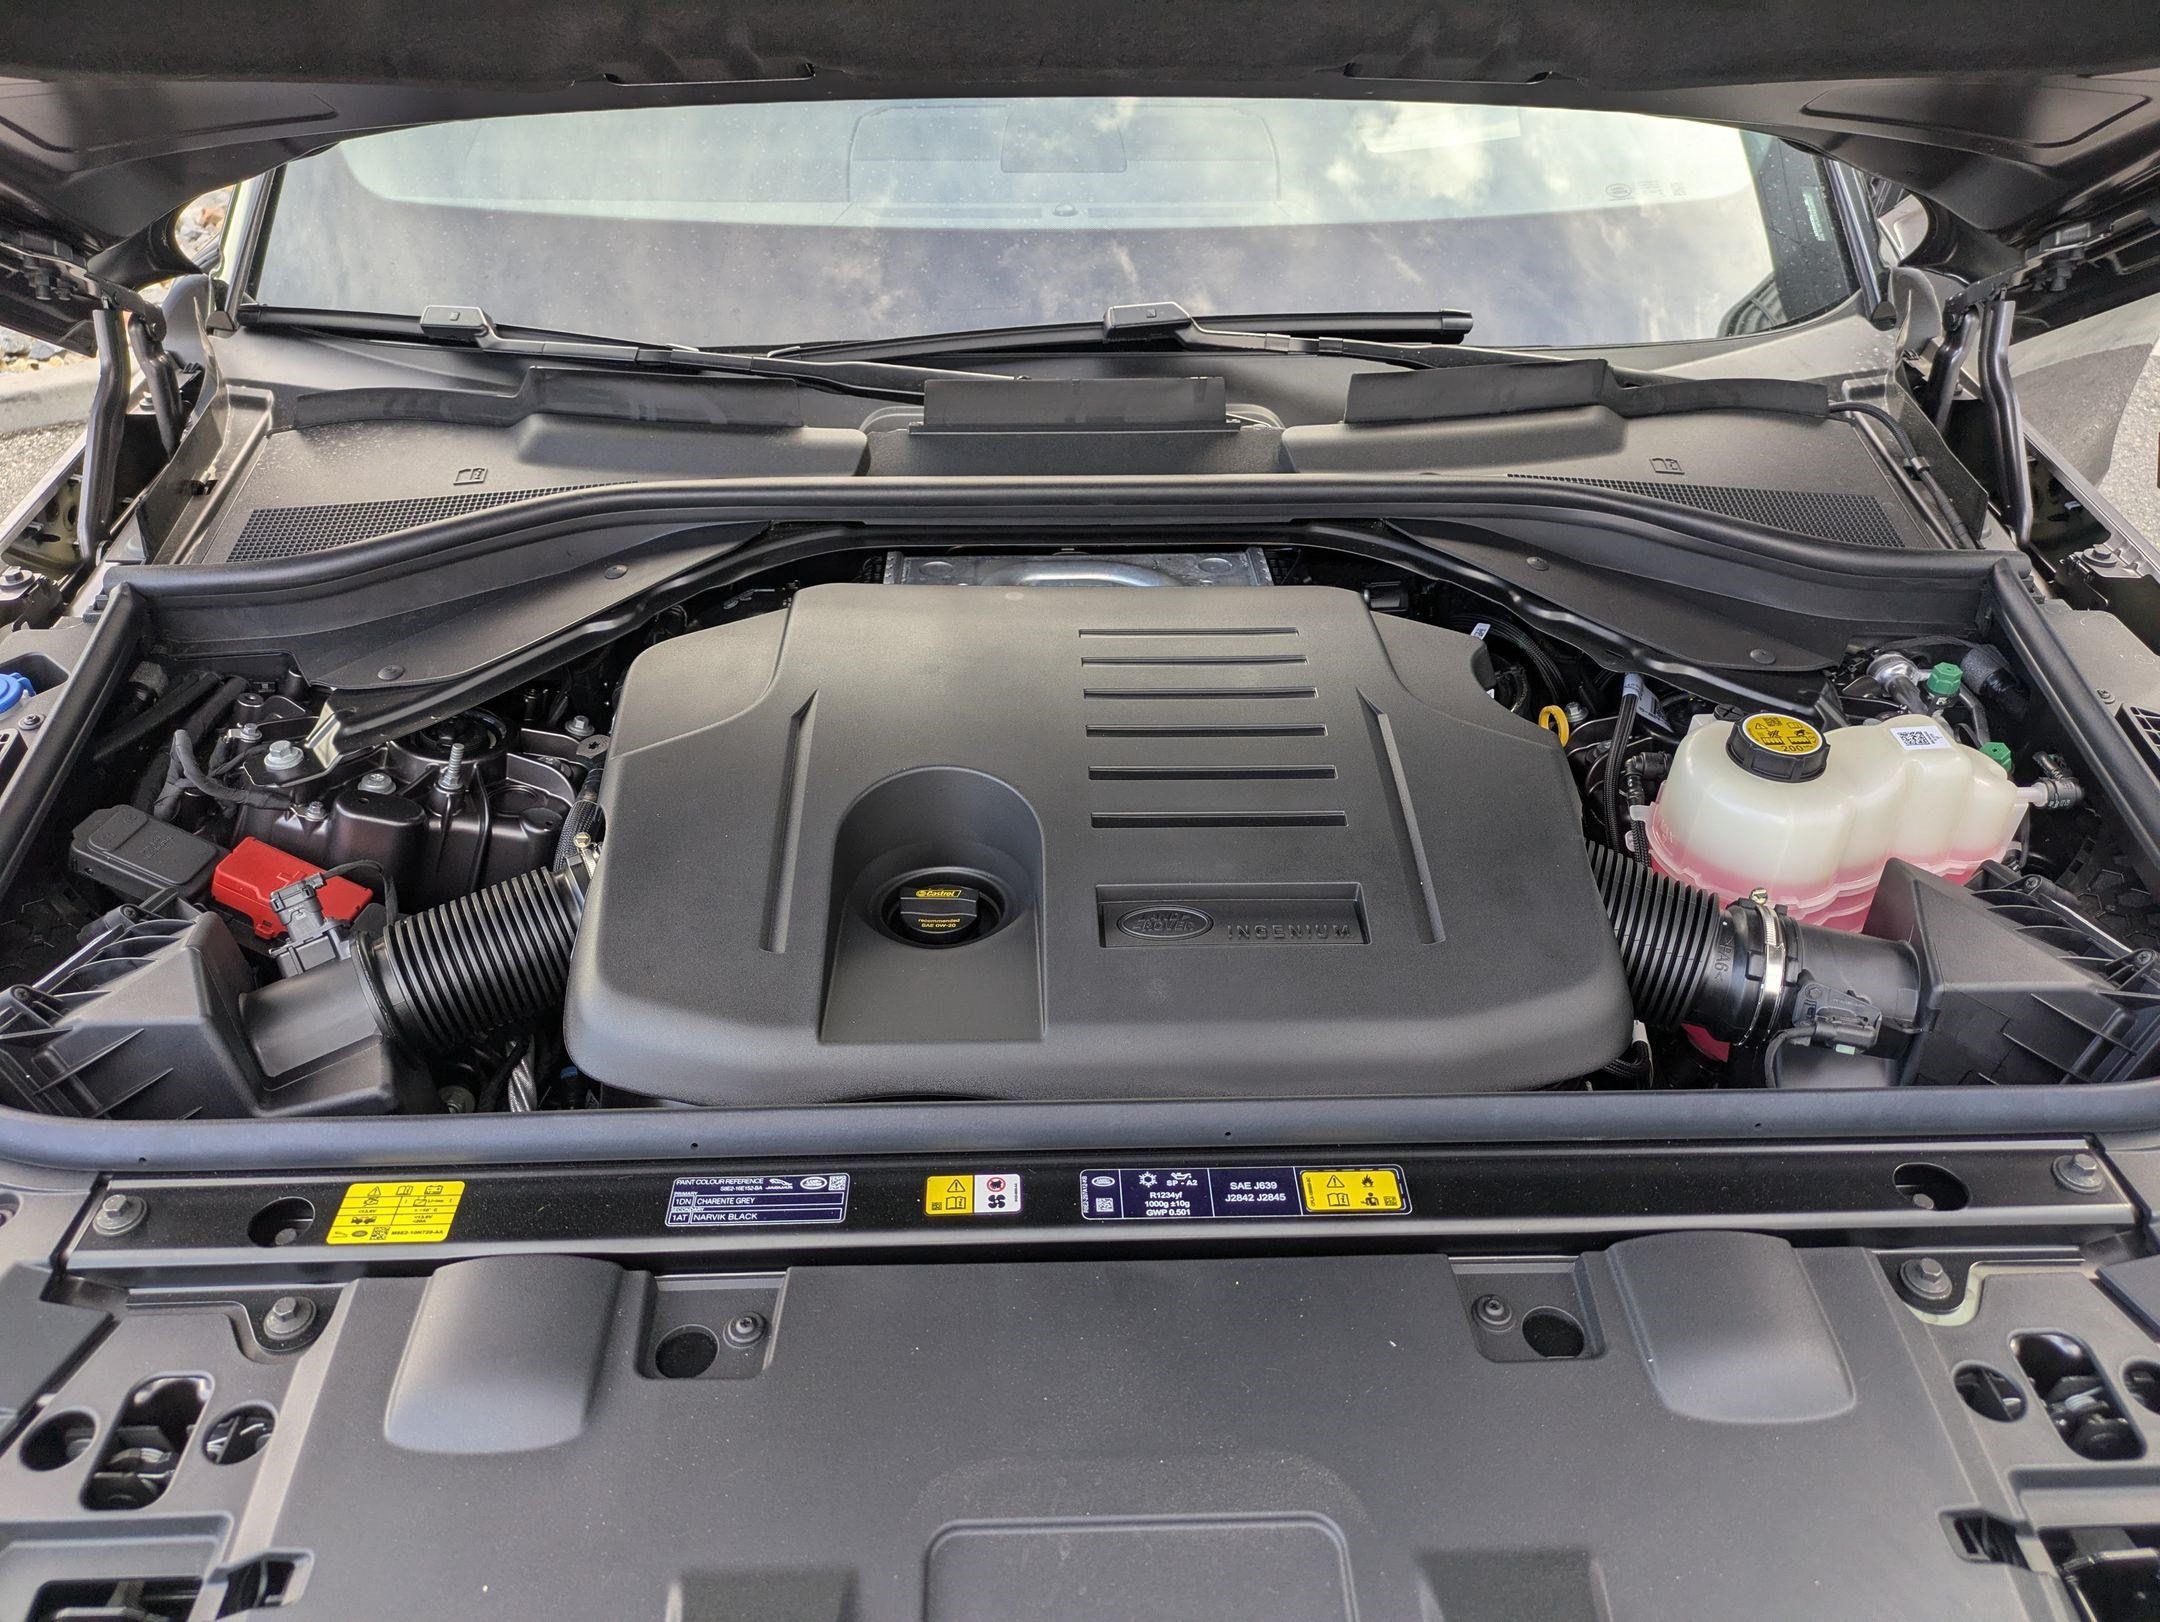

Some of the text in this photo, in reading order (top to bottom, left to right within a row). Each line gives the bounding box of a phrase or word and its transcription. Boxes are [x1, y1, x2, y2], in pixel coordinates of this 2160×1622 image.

[1782, 744, 1804, 752] 200
[1227, 924, 1352, 939] INGENIUM
[1230, 1181, 1277, 1190] SAE J639
[675, 1197, 755, 1206] 1DN CHARENTE GREY
[1225, 1193, 1286, 1202] J2842 J2845
[1170, 1200, 1190, 1208] ±10g
[691, 1213, 726, 1221] NARVIK
[727, 1213, 758, 1221] BLACK
[1146, 1209, 1167, 1217] GWP
